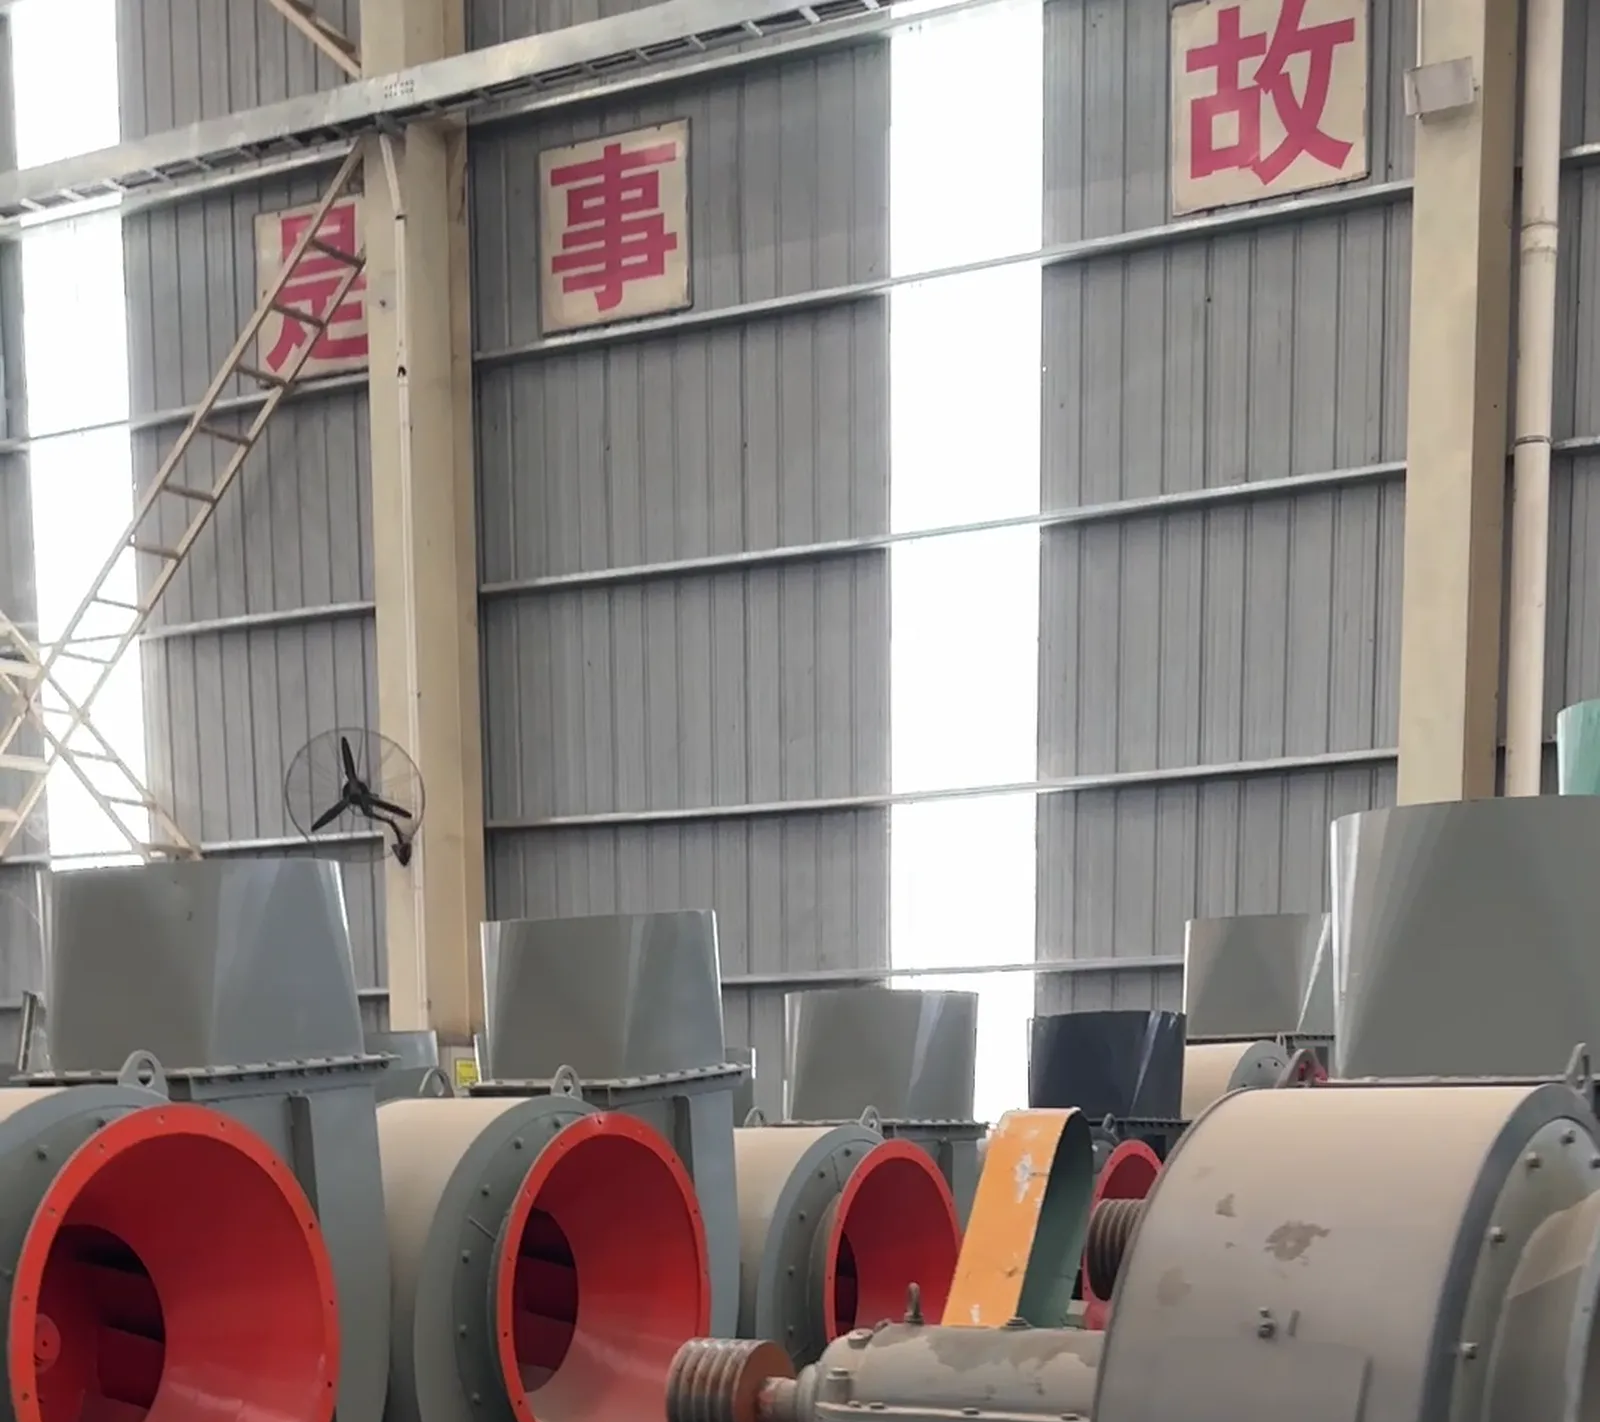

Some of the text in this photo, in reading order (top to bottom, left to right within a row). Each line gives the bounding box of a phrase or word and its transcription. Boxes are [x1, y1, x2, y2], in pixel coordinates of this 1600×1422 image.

[1186, 0, 1355, 186] 故
[265, 204, 369, 373] 是
[551, 143, 678, 312] 事
